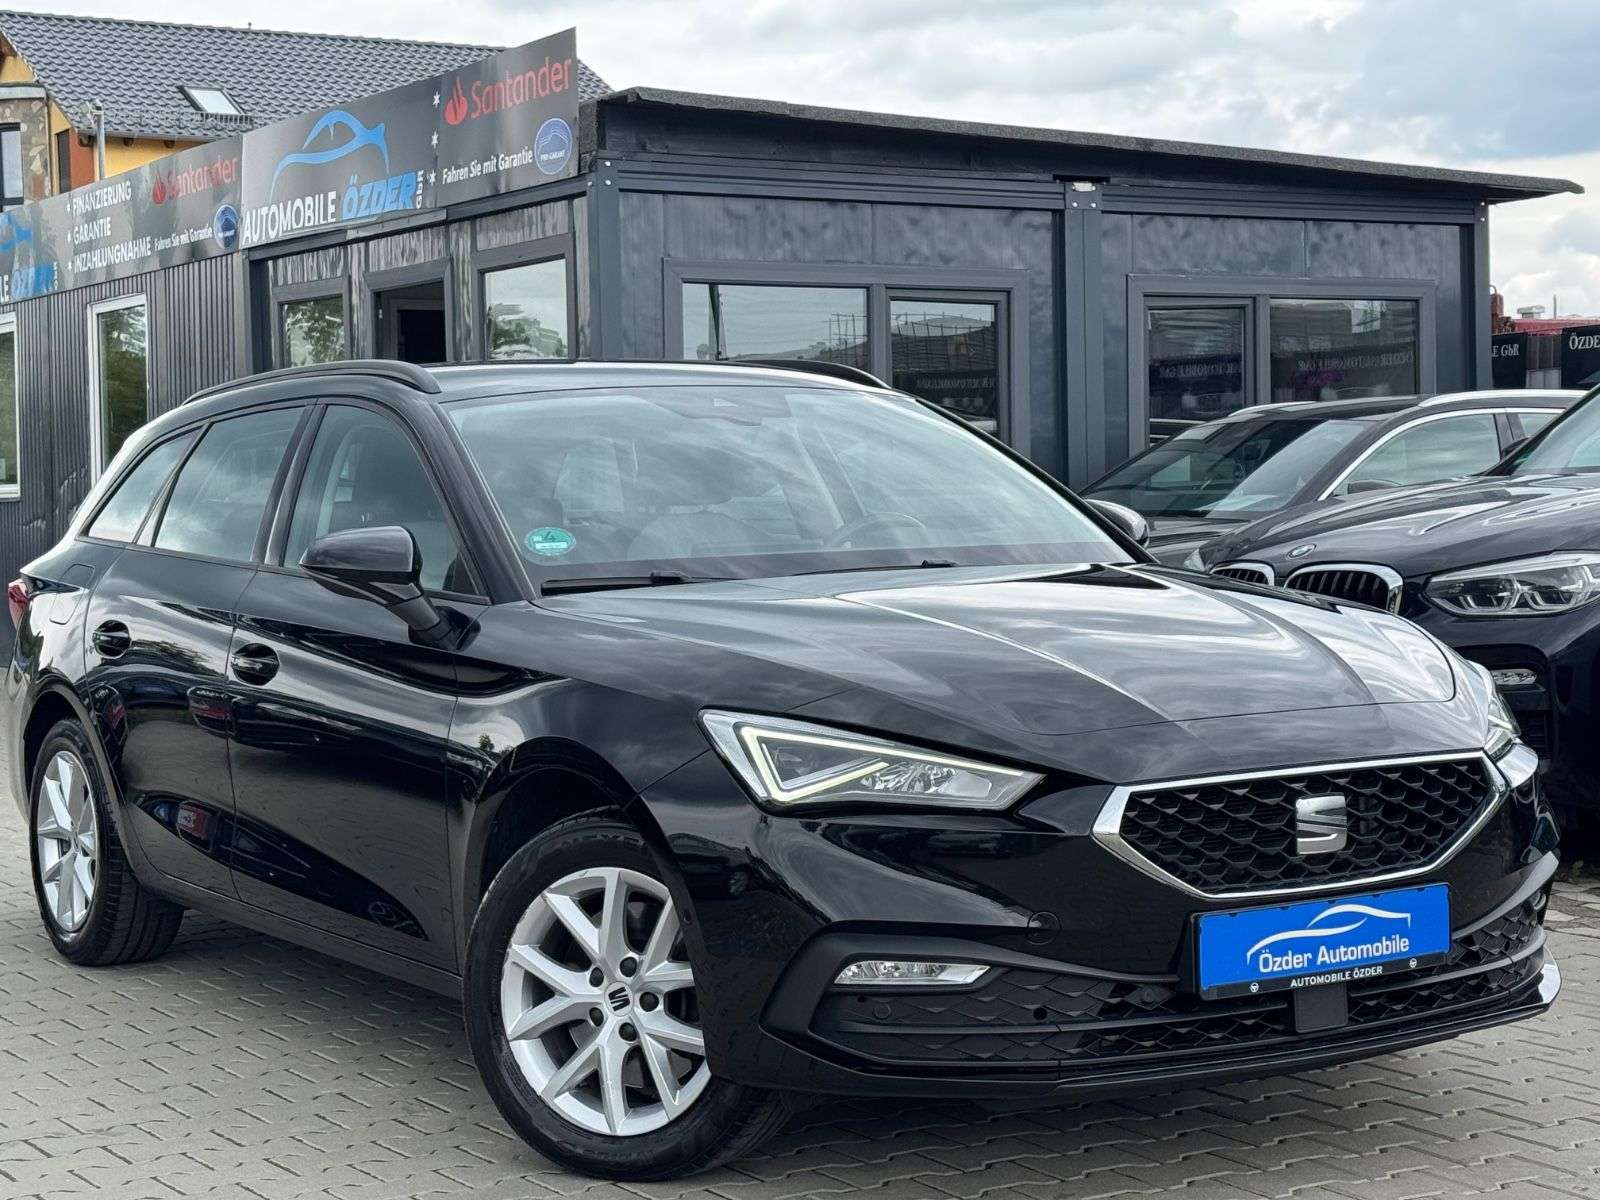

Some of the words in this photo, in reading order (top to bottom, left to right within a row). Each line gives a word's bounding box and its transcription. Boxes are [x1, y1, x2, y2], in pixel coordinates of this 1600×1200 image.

[470, 56, 572, 118] Santander
[167, 154, 238, 200] Santander
[442, 165, 468, 184] Fahren
[470, 160, 482, 178] Sie
[483, 155, 497, 174] mit
[498, 146, 533, 171] Garantie
[72, 180, 132, 216] FINANZIERUNG
[242, 190, 337, 245] AUTOMOBILE
[341, 171, 417, 222] ÖZDER
[73, 217, 111, 244] GARANTIE
[74, 236, 151, 273] INZAHLUNGNAHME
[1501, 343, 1519, 357] GbR
[1259, 948, 1312, 973] Özder
[1317, 934, 1410, 965] Automobile
[1290, 970, 1351, 988] AUTOMOBILE
[1353, 965, 1383, 979] ÖZDER
